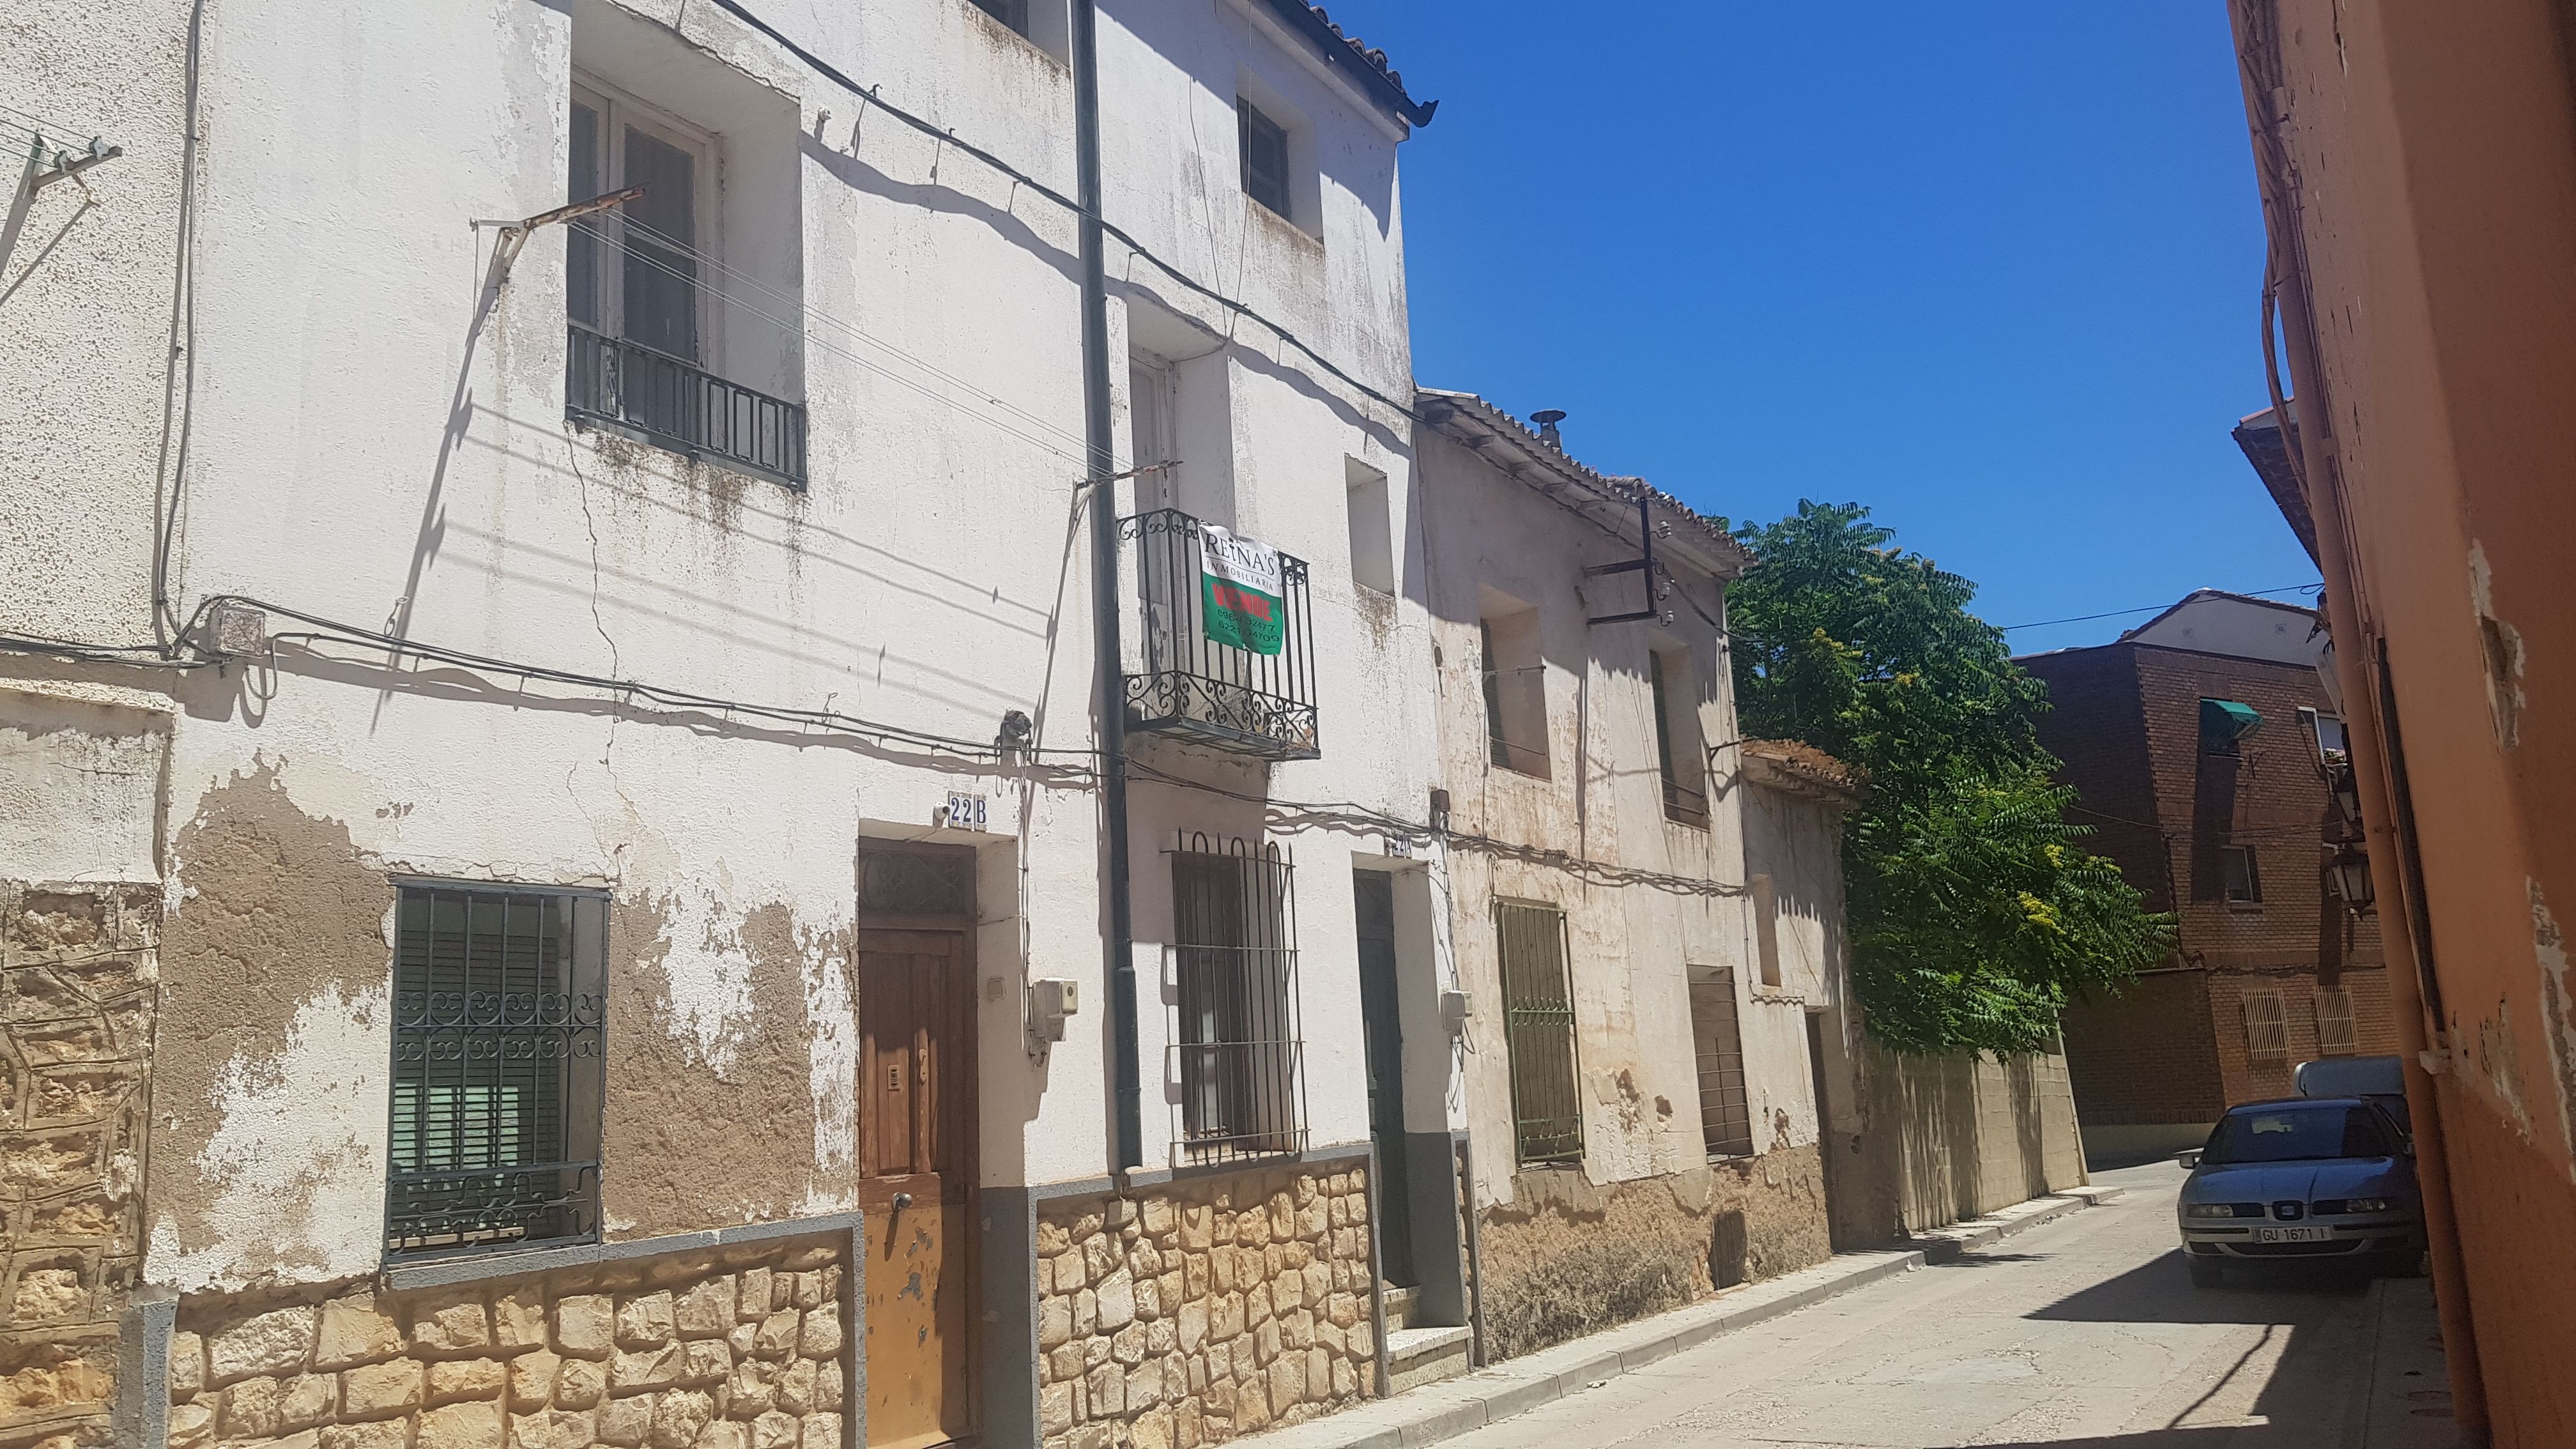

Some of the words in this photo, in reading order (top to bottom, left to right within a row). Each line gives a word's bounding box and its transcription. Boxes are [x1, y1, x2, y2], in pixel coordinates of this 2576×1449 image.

[1207, 561, 1273, 592] INMOBILIARIA
[1213, 583, 1273, 620] VENDE
[2263, 1230, 2278, 1241] GU
[2285, 1229, 2312, 1240] 1671
